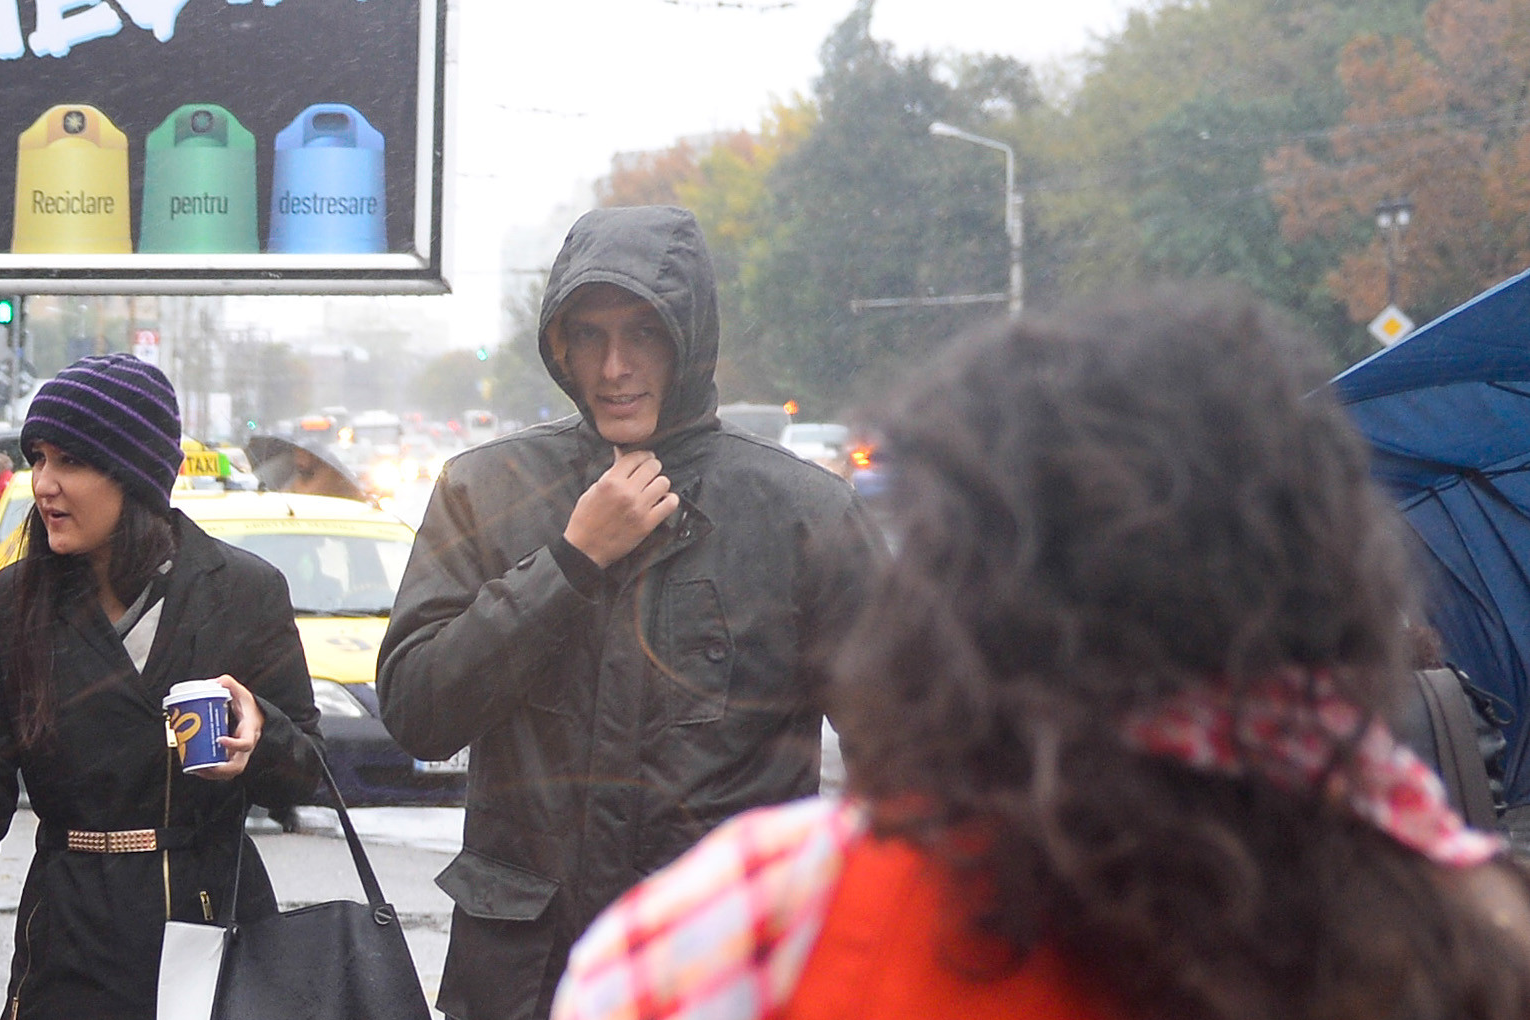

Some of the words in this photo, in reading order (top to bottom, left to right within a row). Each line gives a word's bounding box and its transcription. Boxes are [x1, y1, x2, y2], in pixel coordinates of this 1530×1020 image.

[32, 189, 116, 214] Reciclare
[170, 191, 229, 220] pentru
[279, 189, 378, 215] destresare
[186, 456, 218, 473] TAXI
